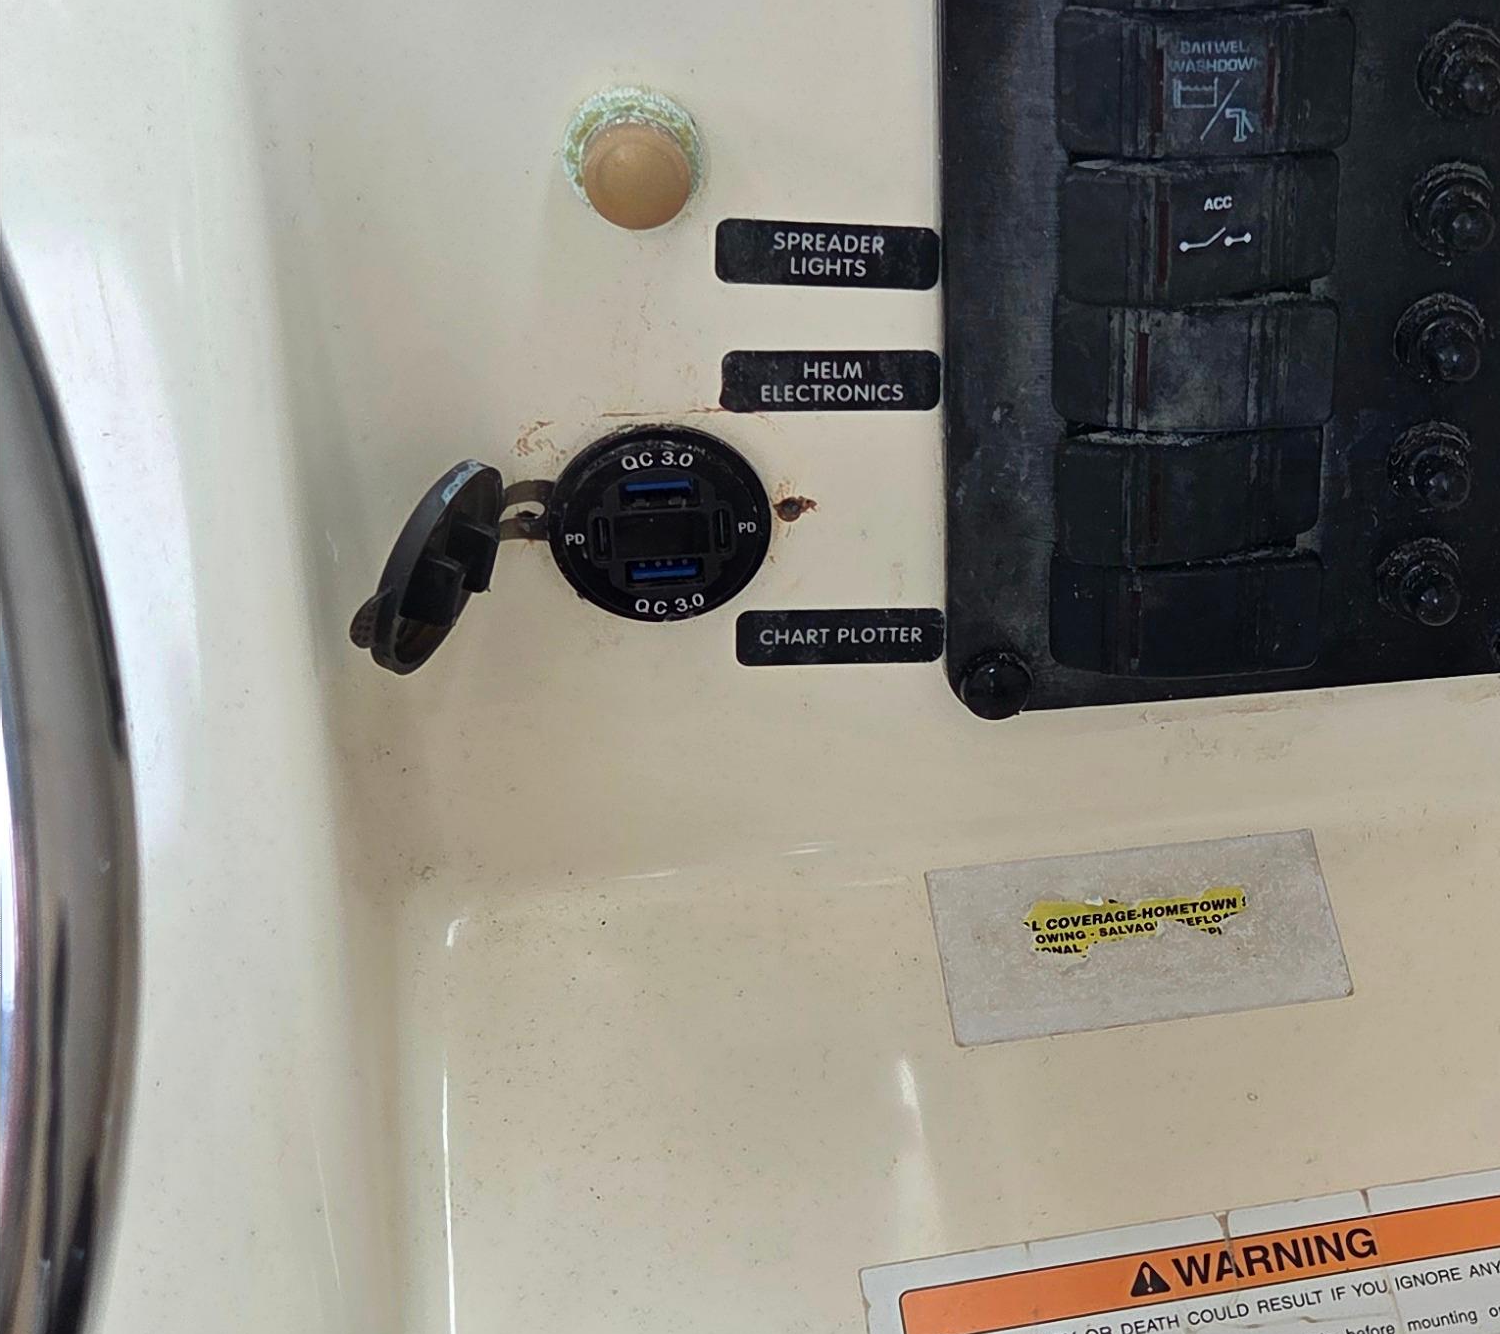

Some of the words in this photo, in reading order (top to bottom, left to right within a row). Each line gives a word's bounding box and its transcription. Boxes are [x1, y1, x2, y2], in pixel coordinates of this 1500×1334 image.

[1203, 195, 1232, 211] ACC
[772, 232, 885, 255] SPREADER
[790, 256, 867, 278] LIGHTS
[803, 361, 863, 379] HELM
[760, 384, 904, 402] ELECTRONICS
[621, 452, 654, 471] QC
[661, 451, 694, 467] 3.0
[738, 521, 757, 534] PD
[565, 533, 586, 546] PD
[634, 598, 668, 615] QC
[674, 593, 705, 613] 3.0
[759, 628, 831, 645] CHART
[837, 627, 923, 644] PLOTTER
[1099, 920, 1158, 937] SALVAG
[1171, 1227, 1378, 1288] WARNING
[1186, 1302, 1250, 1326] COULD
[1256, 1289, 1323, 1315] RESULT
[1330, 1285, 1346, 1302] IF
[1350, 1278, 1388, 1298] YOU
[1394, 1266, 1463, 1292] IGNORE
[1406, 1310, 1479, 1332] mounting
